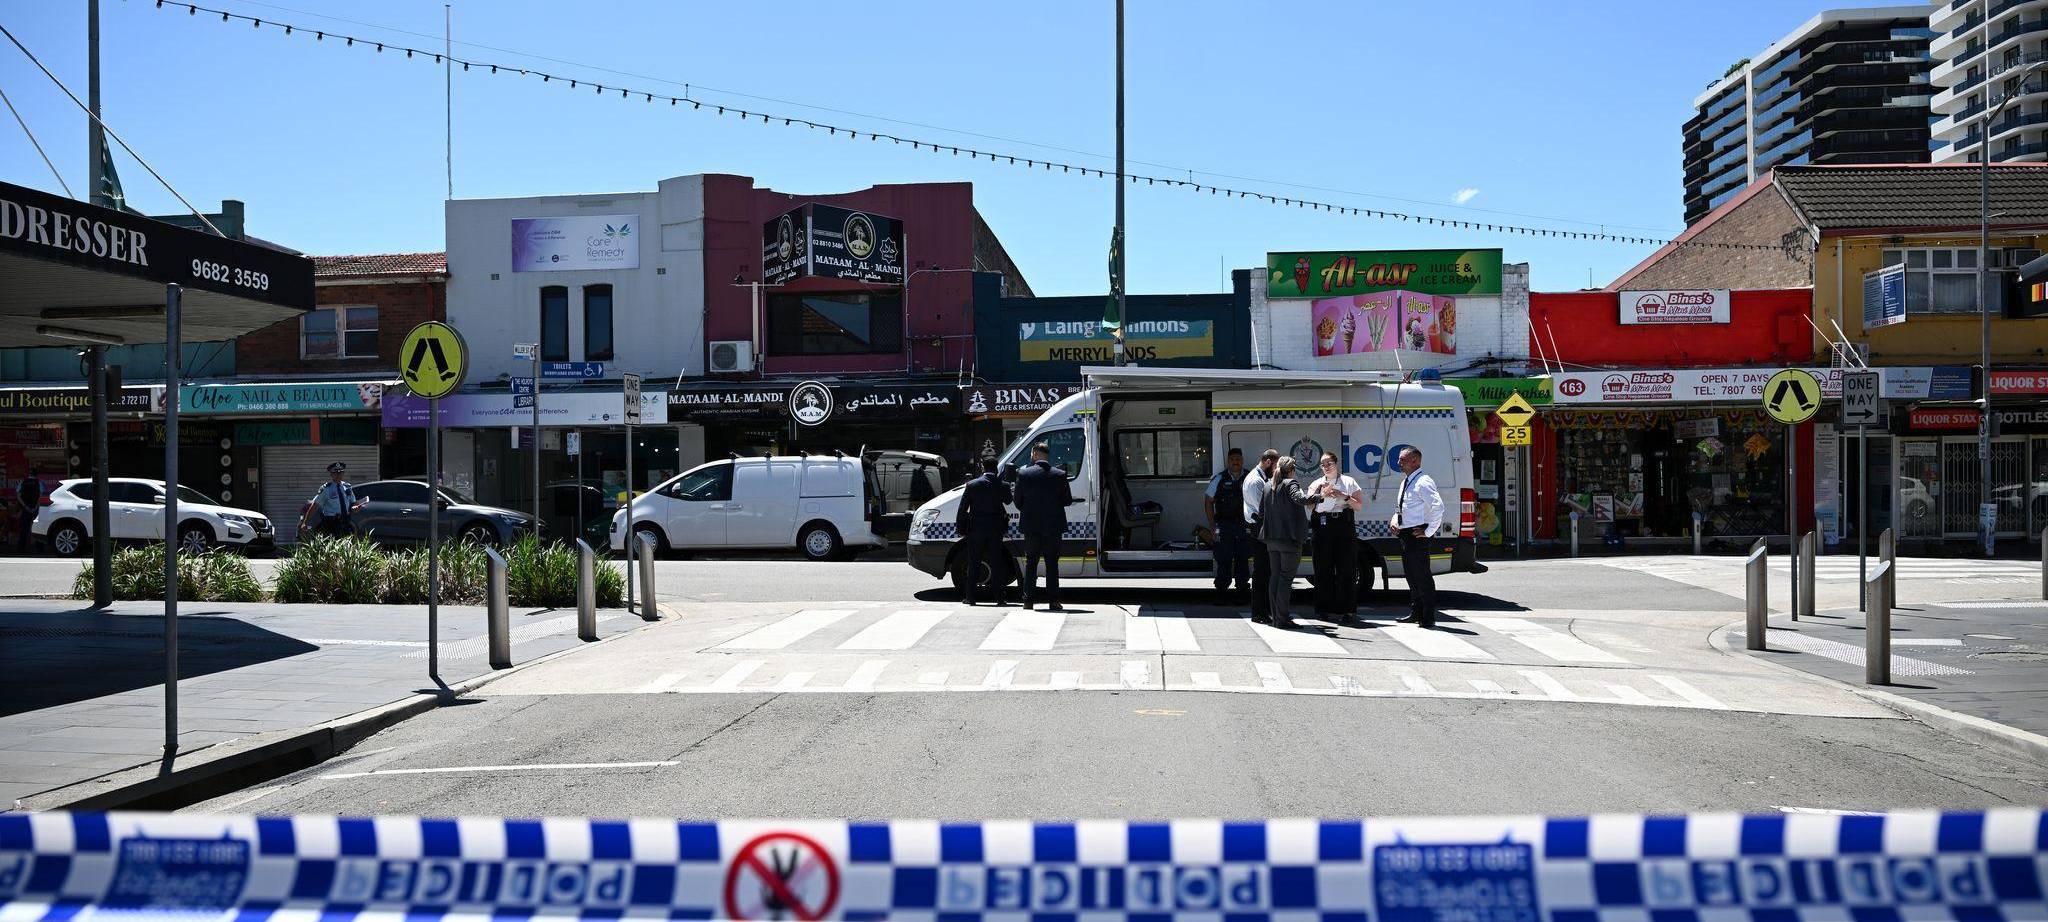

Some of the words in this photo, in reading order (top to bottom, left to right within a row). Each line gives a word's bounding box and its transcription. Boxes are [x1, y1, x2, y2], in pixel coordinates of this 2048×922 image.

[0, 199, 149, 266] DRESSER
[815, 255, 853, 269] MATAAM
[858, 263, 870, 271] AL
[875, 264, 902, 276] MANDI
[1429, 263, 1460, 274] JUICE
[1463, 263, 1473, 273] &
[192, 259, 229, 284] 9682
[234, 267, 269, 291] 3559
[1321, 255, 1418, 292] Al-asr
[1420, 275, 1438, 286] ICE
[1441, 274, 1482, 285] CREAM
[1667, 292, 1714, 306] Binas's
[1666, 305, 1687, 316] Mini
[1688, 305, 1712, 315] Mart
[1049, 346, 1157, 361] MERRYLNDS
[626, 378, 639, 392] ONE
[1630, 373, 1675, 385] Binas's
[1701, 375, 1728, 384] OPEN
[1732, 375, 1739, 383] 7
[1743, 374, 1769, 383] DAYS
[1848, 378, 1873, 390] ONE
[1990, 377, 2035, 390] LIQUOR
[1561, 382, 1583, 394] 163
[1693, 387, 1716, 396] TEL:
[1721, 386, 1745, 395] 7807
[1751, 385, 1764, 394] 69
[191, 386, 234, 409] Chloe
[241, 389, 274, 402] NAIL
[277, 389, 287, 402] &
[293, 387, 348, 402] BEAUTY
[625, 393, 639, 407] WAY
[669, 392, 784, 405] MATAAM-AL-MANDI
[909, 393, 950, 411] مطعم
[994, 387, 1060, 404] BINAS
[1846, 394, 1875, 406] WAY
[994, 404, 1012, 412] CAFE
[1012, 403, 1018, 411] &
[1913, 414, 1950, 426] LIQUOR
[1952, 414, 1977, 425] STAX
[1506, 428, 1527, 440] 25
